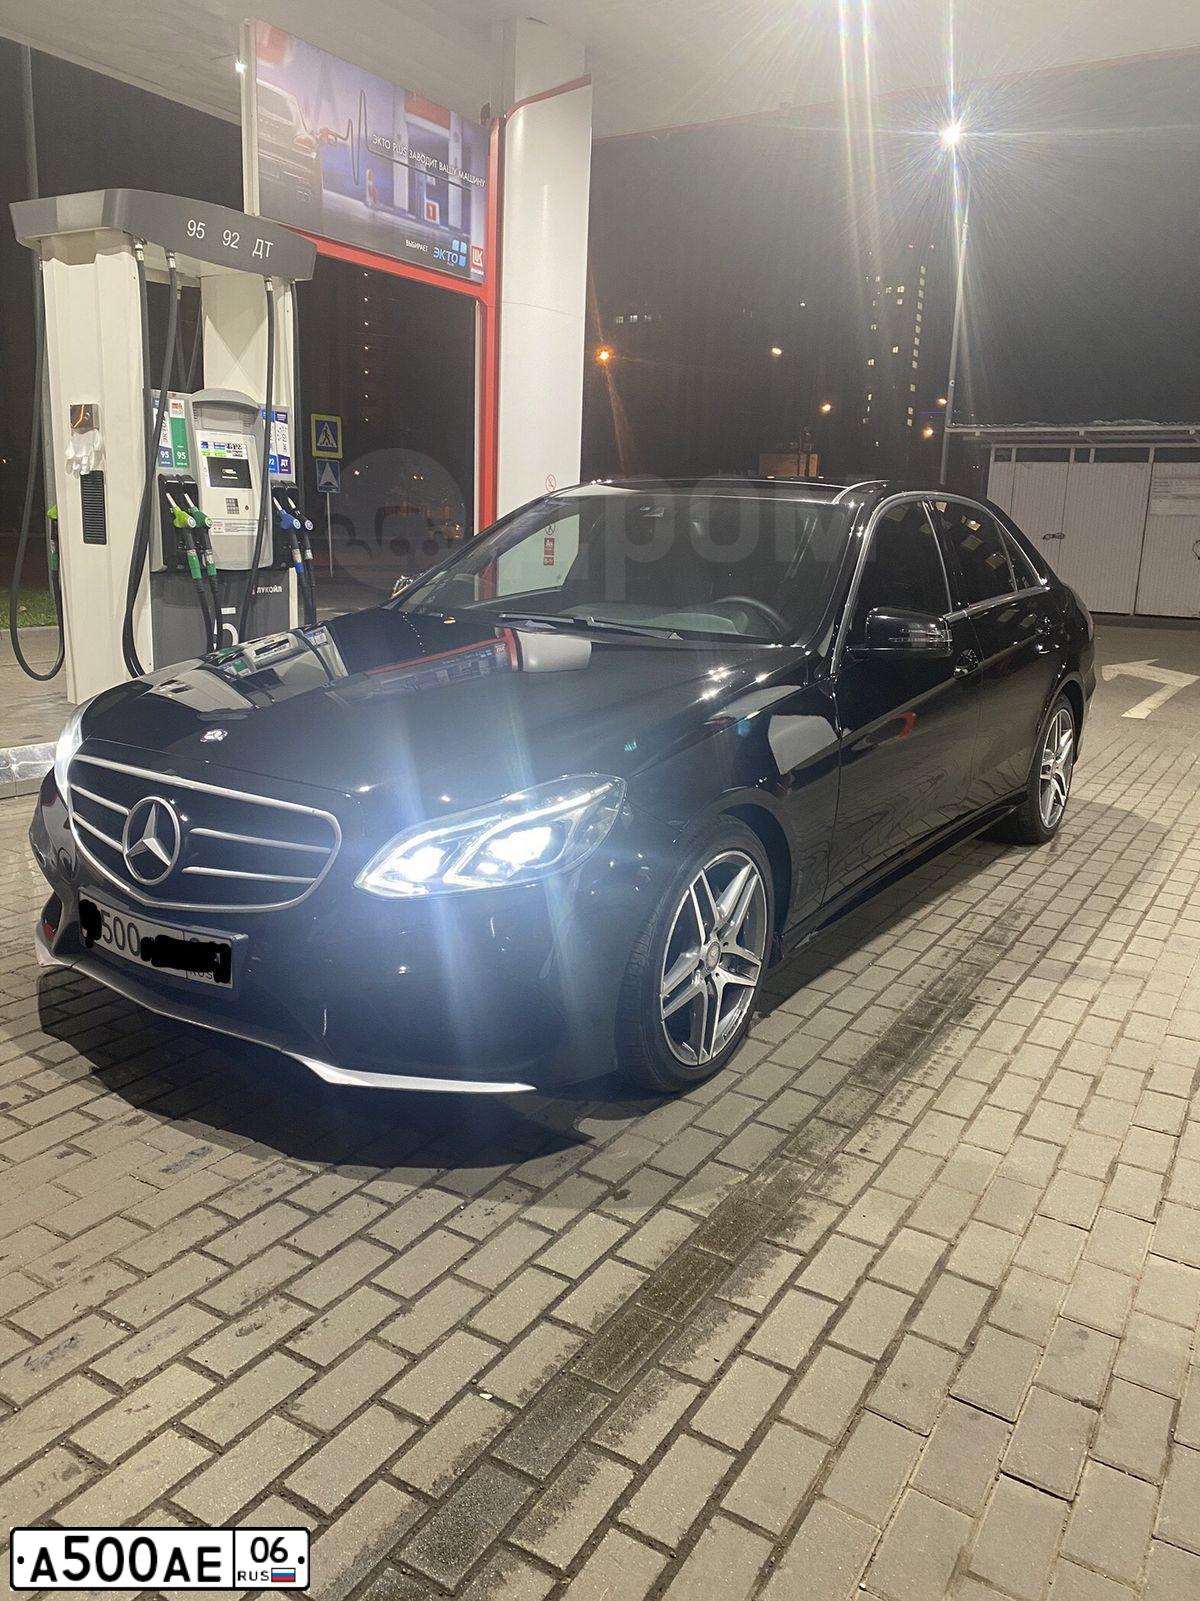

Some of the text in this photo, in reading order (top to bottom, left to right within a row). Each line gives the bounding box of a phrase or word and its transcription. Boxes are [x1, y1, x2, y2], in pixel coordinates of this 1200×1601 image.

[372, 134, 391, 150] ЭКТО
[392, 142, 409, 157] PLUS
[408, 149, 437, 169] ЗАВОДИТ
[458, 170, 486, 188] МАШИНУ
[186, 219, 274, 259] 95 92 ДТ
[433, 246, 458, 264] ЭКТО
[160, 450, 170, 459] 95
[176, 451, 187, 460] 95
[256, 585, 283, 594] ЛУКОЙЛ
